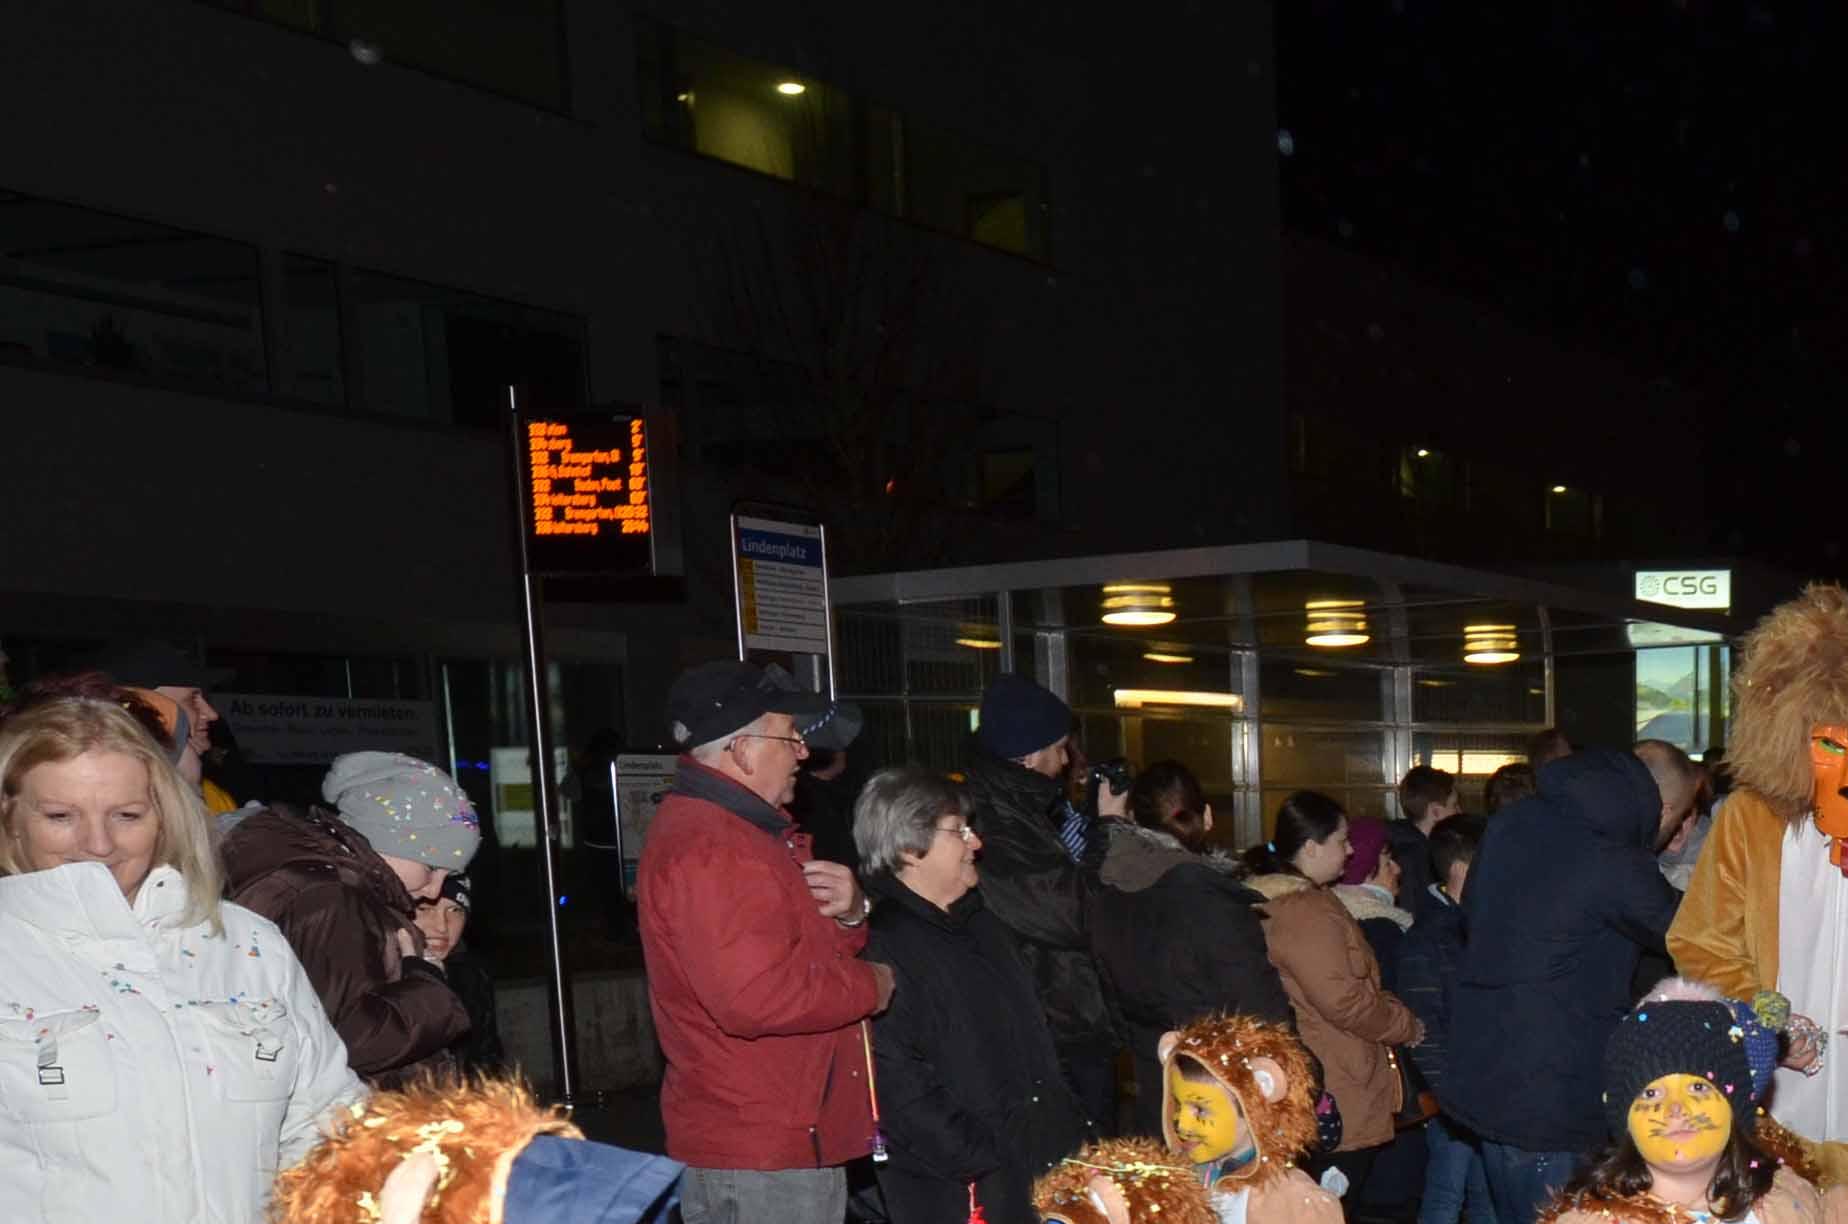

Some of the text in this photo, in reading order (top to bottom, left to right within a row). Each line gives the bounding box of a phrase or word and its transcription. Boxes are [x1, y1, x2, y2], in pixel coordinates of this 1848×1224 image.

[741, 537, 808, 560] Lindenplatz
[1663, 576, 1717, 595] CSG
[231, 699, 254, 715] Ab
[258, 700, 309, 718] sofort
[312, 704, 334, 719] zu
